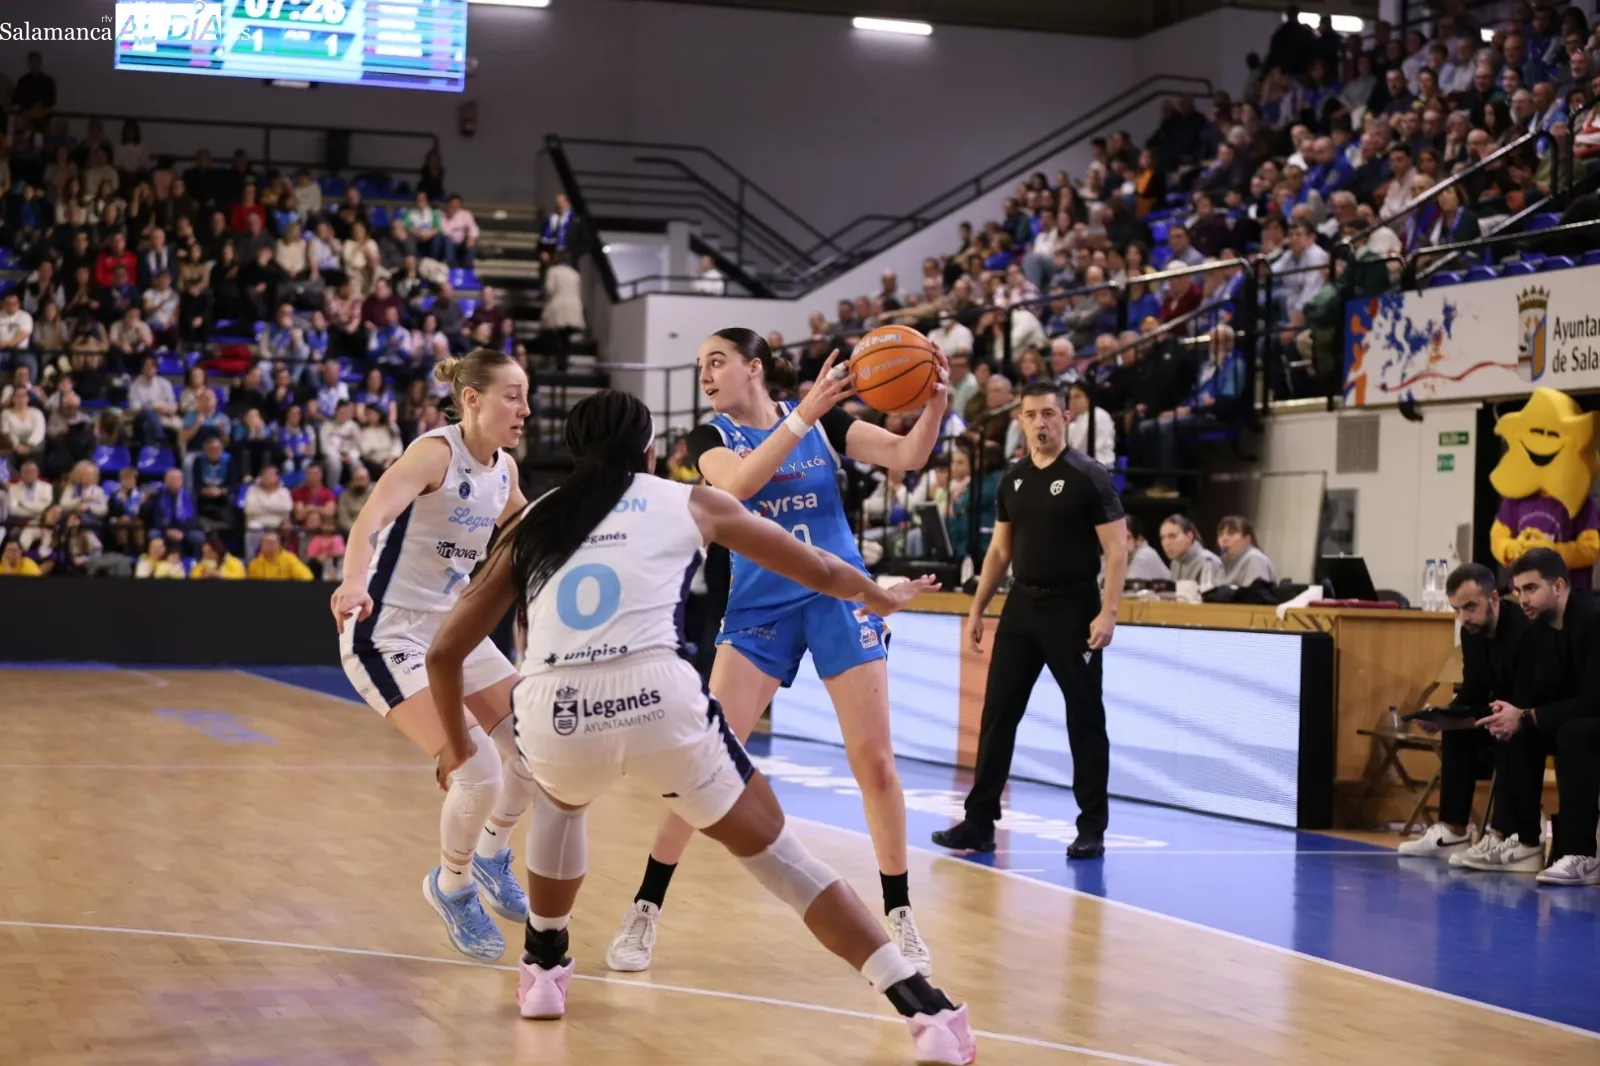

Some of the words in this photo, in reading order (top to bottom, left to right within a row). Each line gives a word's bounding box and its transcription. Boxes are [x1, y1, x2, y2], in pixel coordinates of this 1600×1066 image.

[1552, 314, 1600, 346] Ayunta
[1552, 348, 1567, 373] de
[1571, 344, 1600, 372] Sala
[612, 498, 647, 513] ON
[759, 492, 818, 518] yrsa
[585, 531, 628, 544] eganés
[556, 562, 622, 632] 0
[564, 644, 629, 662] unipiso
[582, 687, 661, 718] Leganés
[584, 708, 666, 734] AYUNTAMIENTO
